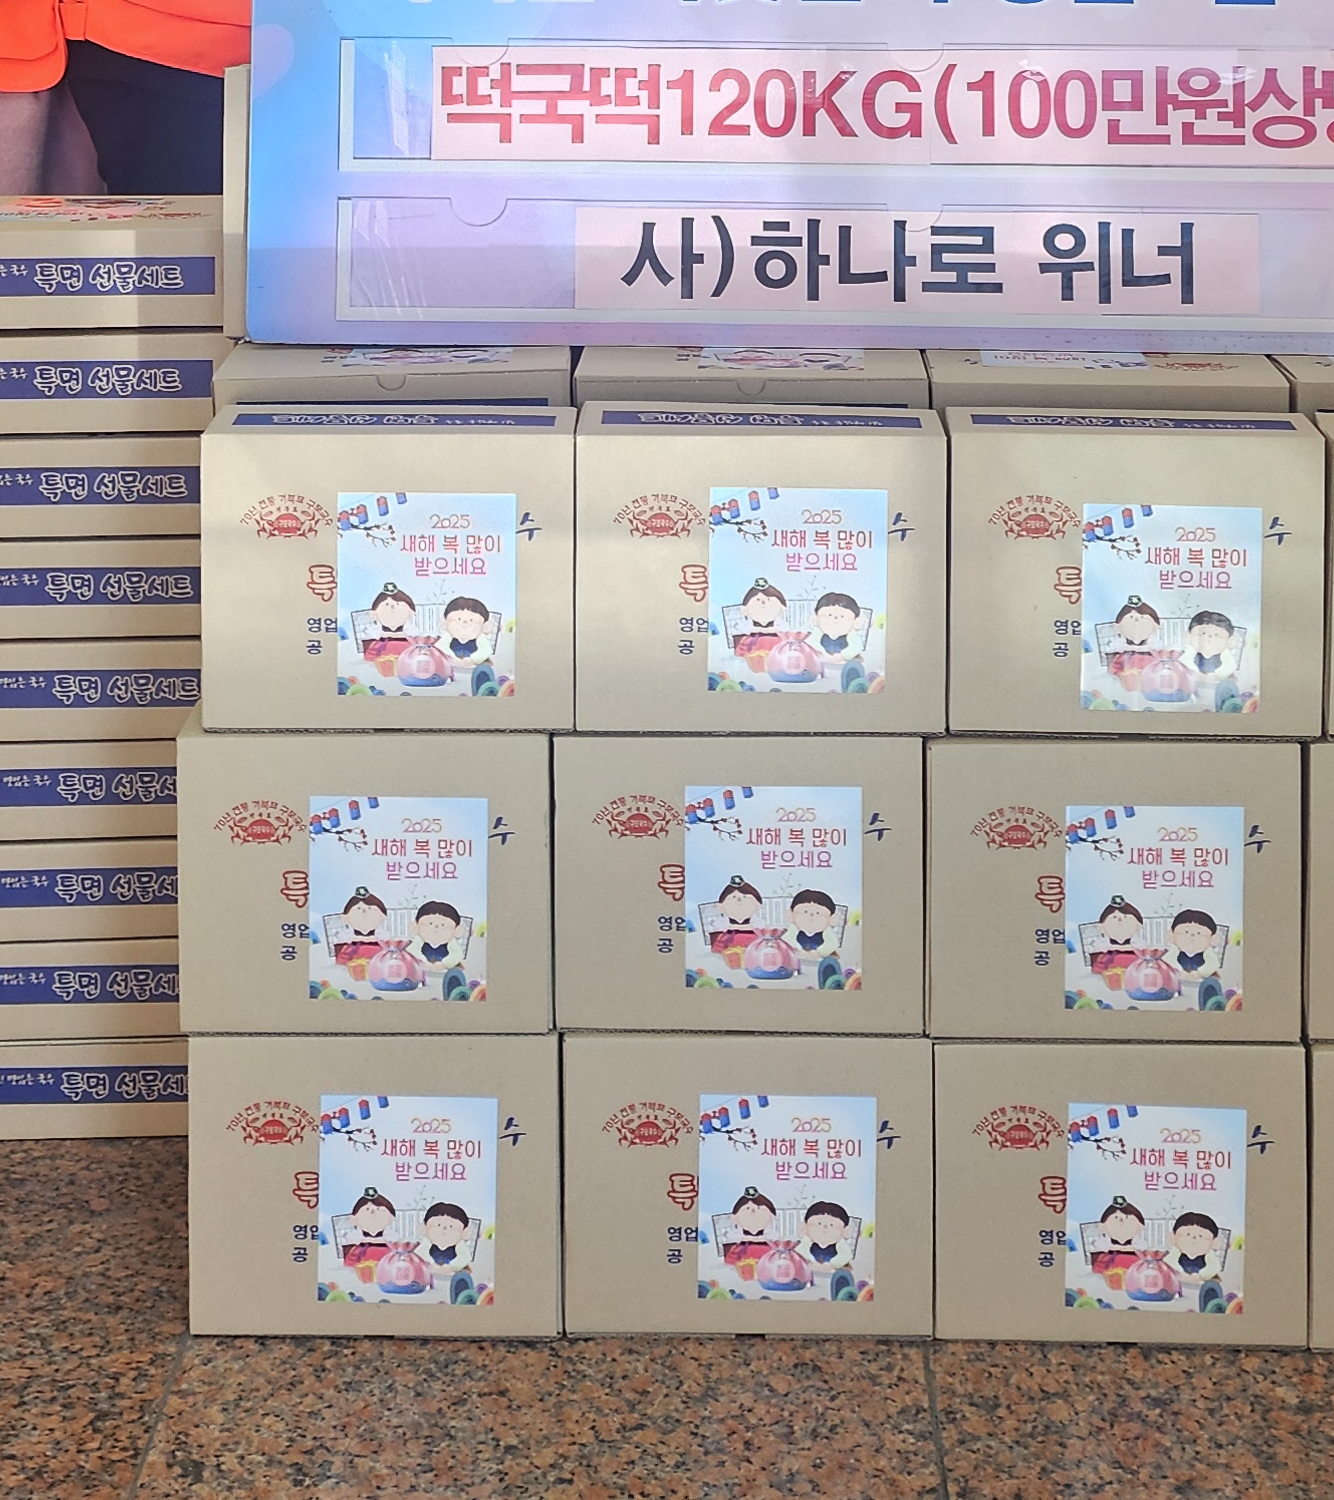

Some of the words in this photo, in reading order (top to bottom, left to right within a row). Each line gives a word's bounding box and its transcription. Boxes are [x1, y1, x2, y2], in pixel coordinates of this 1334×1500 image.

[620, 213, 1004, 304] 사)하나로
[1038, 220, 1195, 305] 위너
[33, 263, 83, 293] 특면
[89, 262, 184, 293] 선물세트
[33, 366, 83, 395] 특면
[88, 365, 182, 396] 선물세트
[39, 472, 88, 501] 특면
[94, 471, 188, 501] 선물세트
[430, 514, 471, 529] 2025
[802, 509, 843, 525] 2025
[772, 530, 807, 549] 새해
[815, 530, 831, 550] 복
[838, 531, 873, 550] 많이
[1175, 526, 1217, 542] 2025
[400, 535, 435, 554] 새해
[443, 535, 459, 554] 복
[466, 535, 501, 554] 많이
[415, 558, 487, 576] 받으세요
[786, 553, 859, 573] 받으세요
[1145, 547, 1180, 567] 새해
[1188, 548, 1204, 567] 복
[1212, 548, 1247, 568] 많이
[45, 572, 94, 601] 특면
[100, 571, 194, 602] 선물세트
[1159, 571, 1233, 591] 받으세요
[52, 675, 100, 705] 특면
[107, 674, 201, 704] 선물세트
[57, 773, 106, 803] 특면
[776, 807, 818, 823] 2025
[402, 818, 443, 833] 2025
[1157, 827, 1199, 842] 2025
[747, 828, 781, 847] 새해
[789, 828, 805, 847] 복
[813, 828, 848, 847] 많이
[372, 839, 407, 857] 새해
[415, 839, 431, 858] 복
[438, 839, 474, 858] 많이
[1127, 848, 1162, 866] 새해
[1170, 848, 1186, 867] 복
[1194, 848, 1230, 867] 많이
[761, 851, 833, 870] 받으세요
[386, 862, 459, 881] 받으세요
[1142, 871, 1215, 889] 받으세요
[54, 872, 103, 903] 특면
[110, 872, 178, 903] 선물세
[52, 970, 100, 1001] 특면
[107, 969, 179, 1000] 선물세
[61, 1071, 108, 1101] 특면
[116, 1070, 189, 1101] 선물세
[411, 1118, 453, 1134] 2025
[791, 1117, 832, 1132] 2025
[1160, 1127, 1202, 1143] 2025
[381, 1139, 416, 1158] 새해
[424, 1139, 440, 1159] 복
[447, 1139, 483, 1159] 많이
[761, 1138, 796, 1156] 새해
[803, 1138, 819, 1157] 복
[827, 1138, 862, 1157] 많이
[1130, 1147, 1165, 1167] 새해
[1173, 1148, 1189, 1168] 복
[1196, 1149, 1232, 1169] 많이
[395, 1162, 468, 1182] 받으세요
[775, 1161, 847, 1179] 받으세요
[1144, 1171, 1217, 1192] 받으세요
